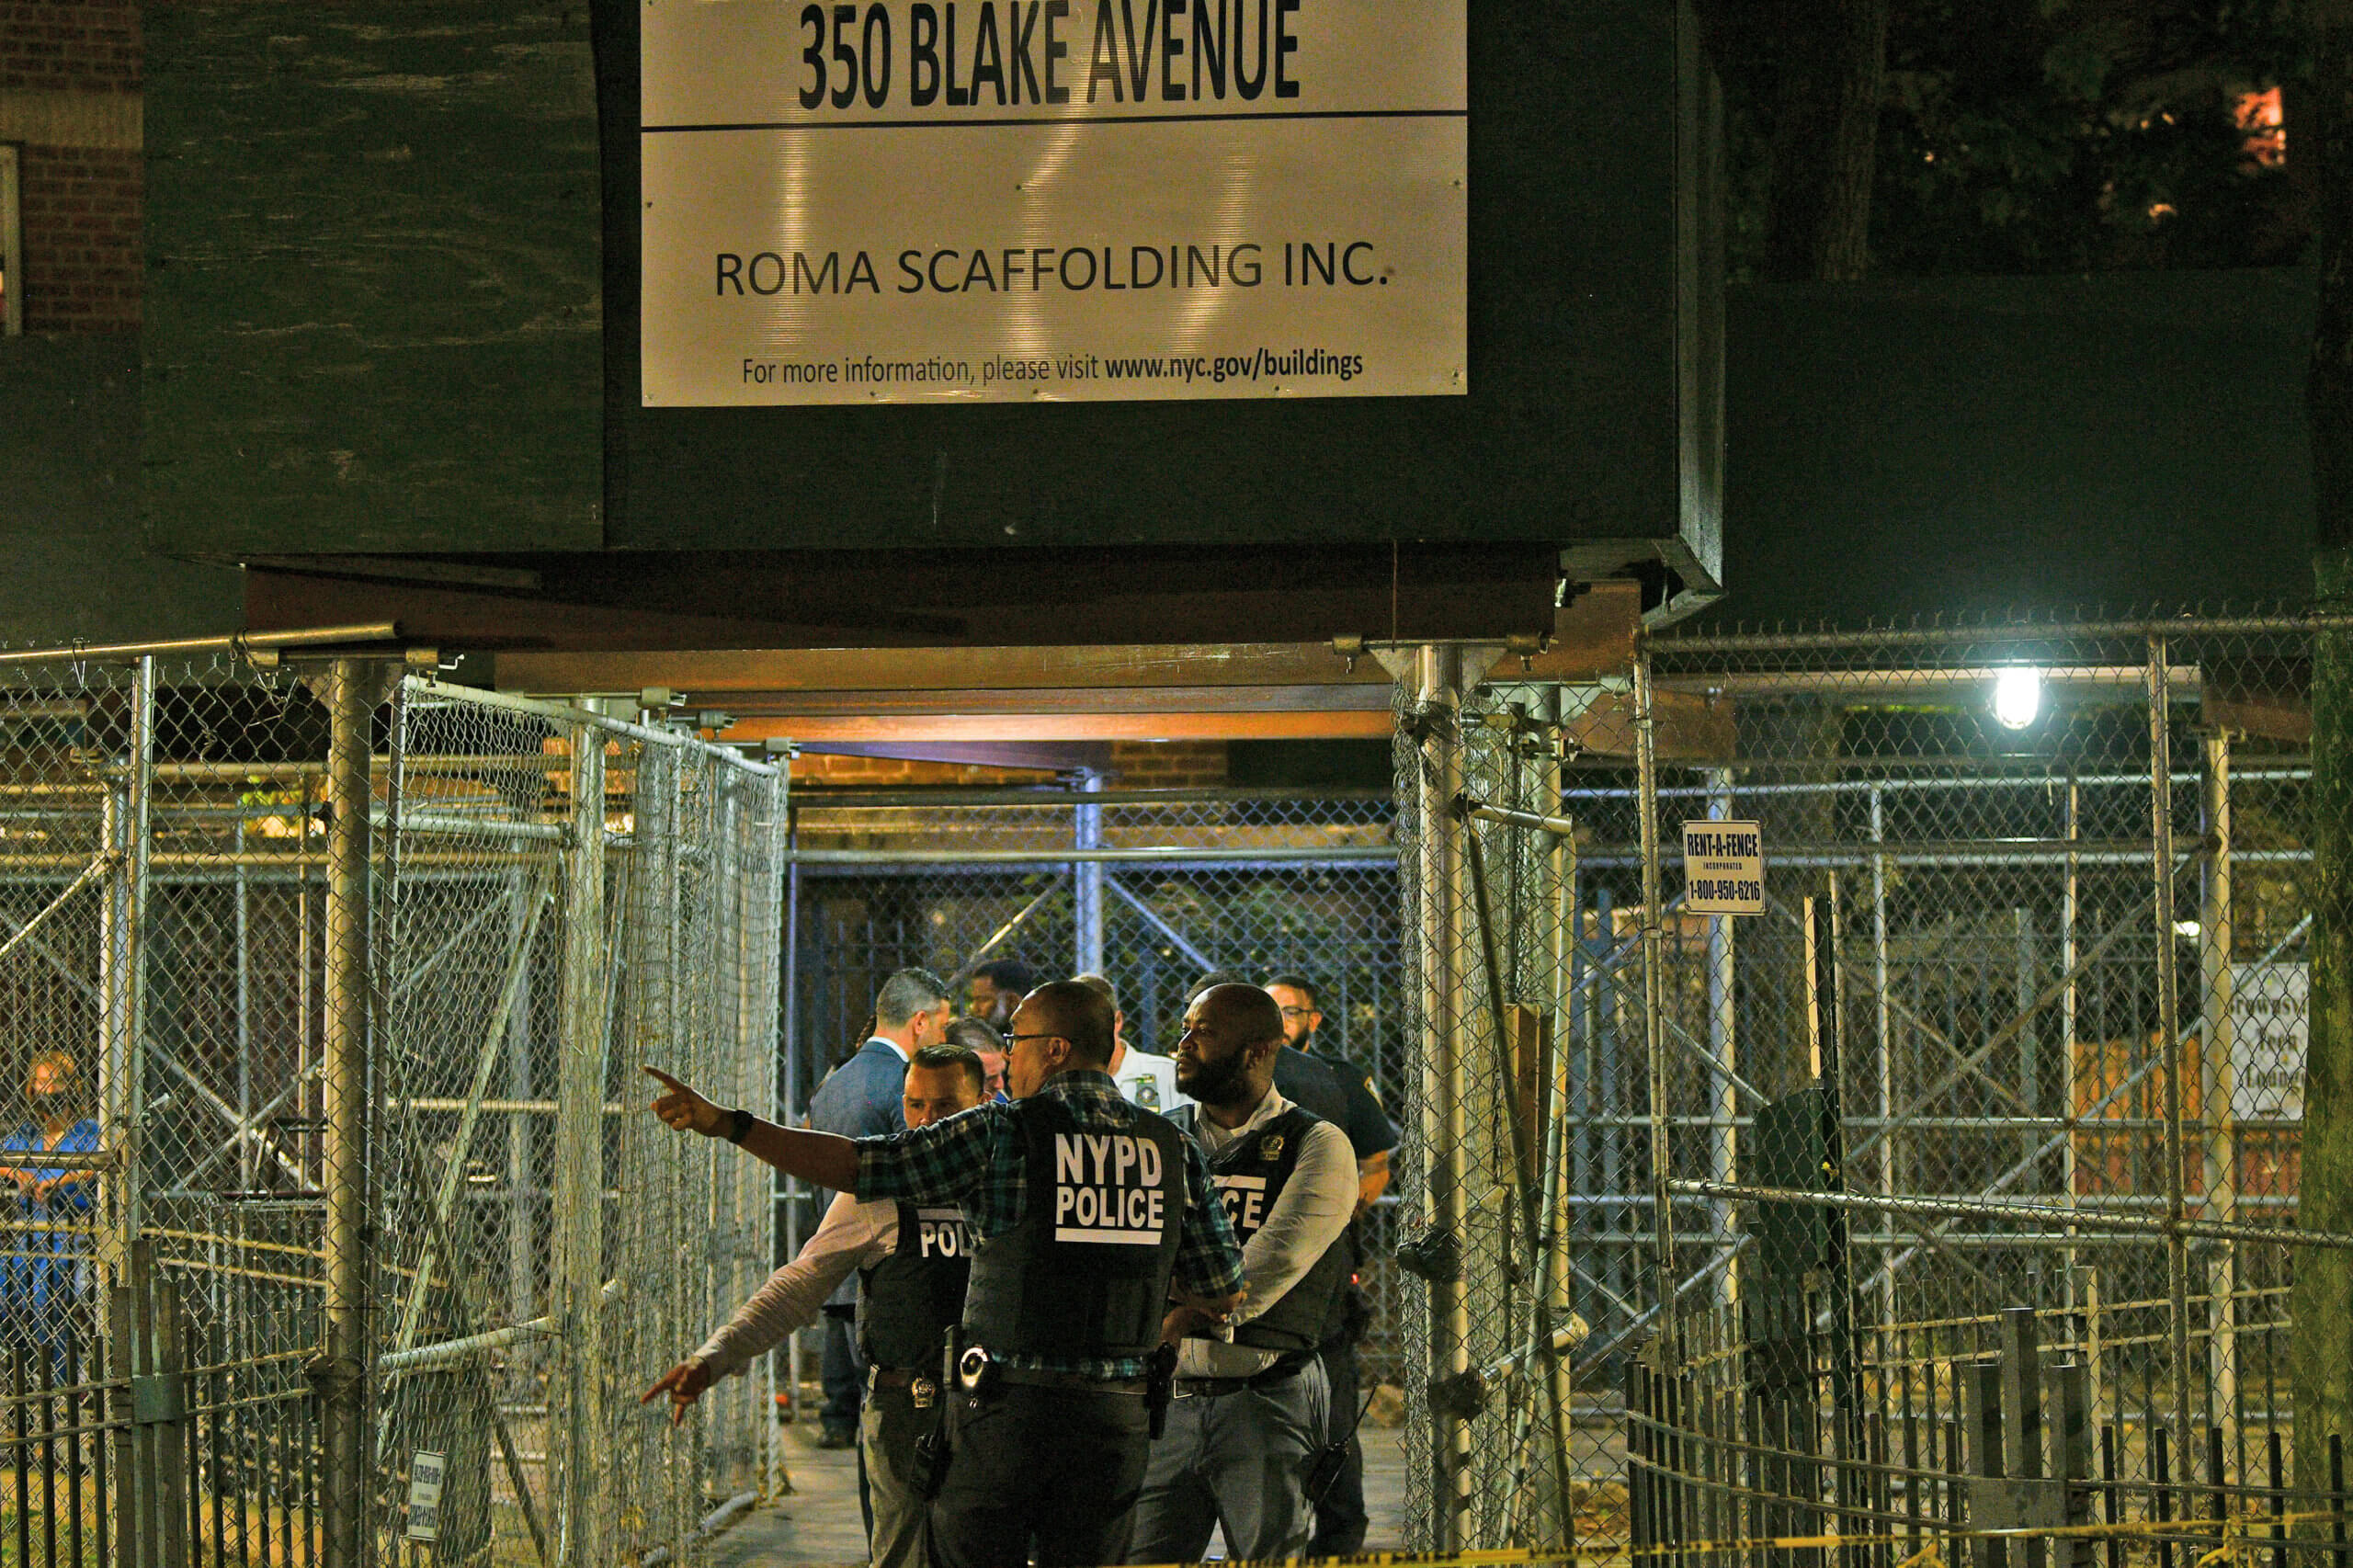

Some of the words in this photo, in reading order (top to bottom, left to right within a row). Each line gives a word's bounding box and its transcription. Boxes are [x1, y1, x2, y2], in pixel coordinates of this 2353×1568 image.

[799, 2, 892, 109] 350
[910, 0, 1070, 108] BLAKE
[1086, 0, 1301, 104] AVENUE
[715, 250, 881, 297] ROMA
[896, 243, 1263, 294] SCAFFOLDING
[1283, 240, 1389, 287] INC.
[742, 358, 778, 384] For
[783, 363, 838, 383] more
[844, 354, 975, 386] information,
[983, 353, 1051, 387] please
[1055, 353, 1099, 380] visit
[1104, 347, 1363, 384] www.nyc.gov/buildings
[1687, 833, 1758, 858] RENT-A-FENCE
[1689, 880, 1760, 901] 1-800-950-6216
[1054, 1132, 1162, 1187] NYPD
[1055, 1186, 1165, 1229] POLICE
[919, 1221, 972, 1258] POL
